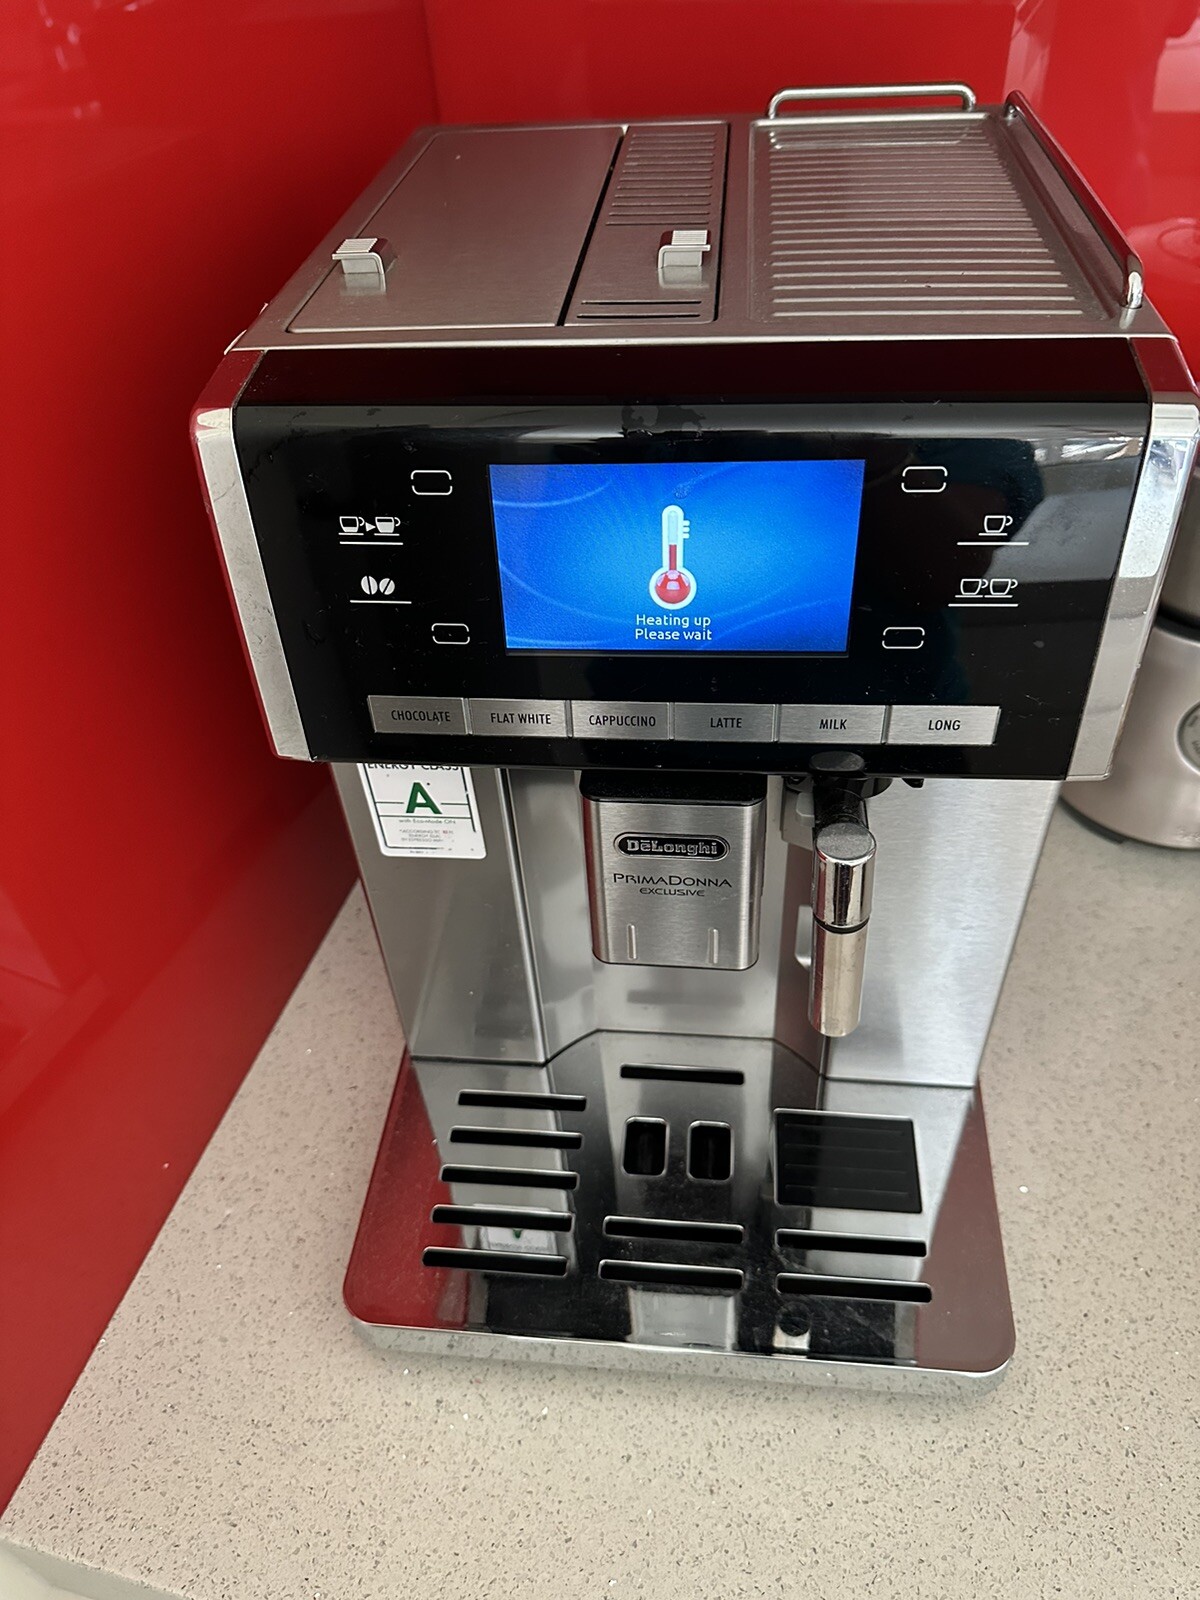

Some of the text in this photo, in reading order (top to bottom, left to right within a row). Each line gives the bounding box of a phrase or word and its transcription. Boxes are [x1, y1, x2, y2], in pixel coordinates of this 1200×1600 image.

[636, 613, 711, 630] Heating up
[635, 628, 712, 640] Please wait
[391, 709, 451, 722] CHOCOLATE
[490, 712, 552, 725] FLAT WHITE
[588, 714, 656, 727] CAPPUCCINO
[710, 717, 743, 729] LATTE
[819, 718, 847, 730] MILK
[928, 719, 961, 731] LONG
[405, 781, 443, 815] A
